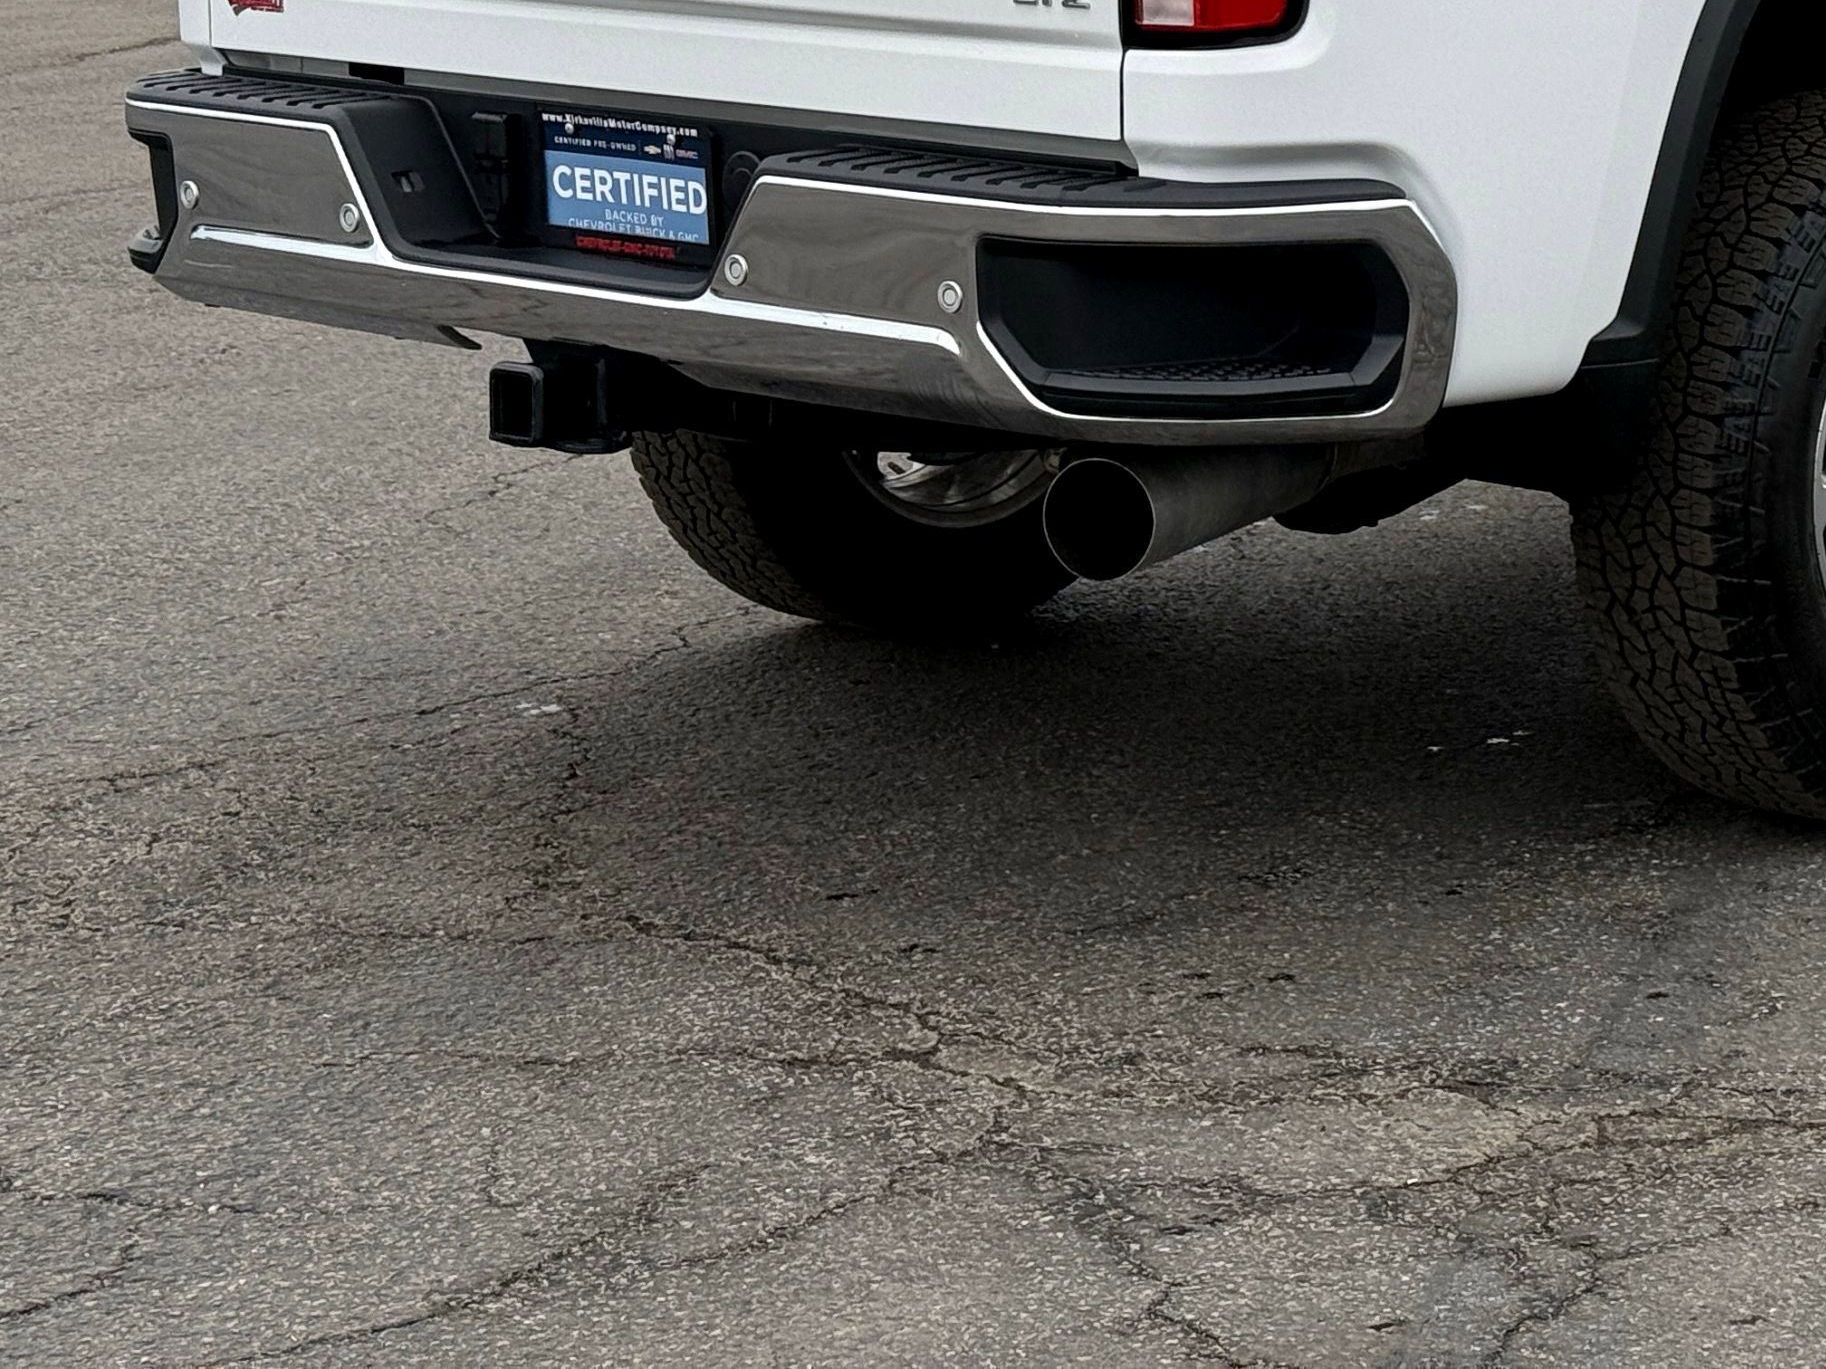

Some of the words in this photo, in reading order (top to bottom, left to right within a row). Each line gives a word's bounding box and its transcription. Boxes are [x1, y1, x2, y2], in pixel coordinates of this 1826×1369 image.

[554, 135, 592, 147] CERTIFIED
[675, 149, 699, 160] GMC
[552, 165, 708, 215] CERTIFIED
[605, 208, 648, 225] BACKED
[651, 214, 665, 227] BY
[568, 218, 632, 234] CHEVROLET
